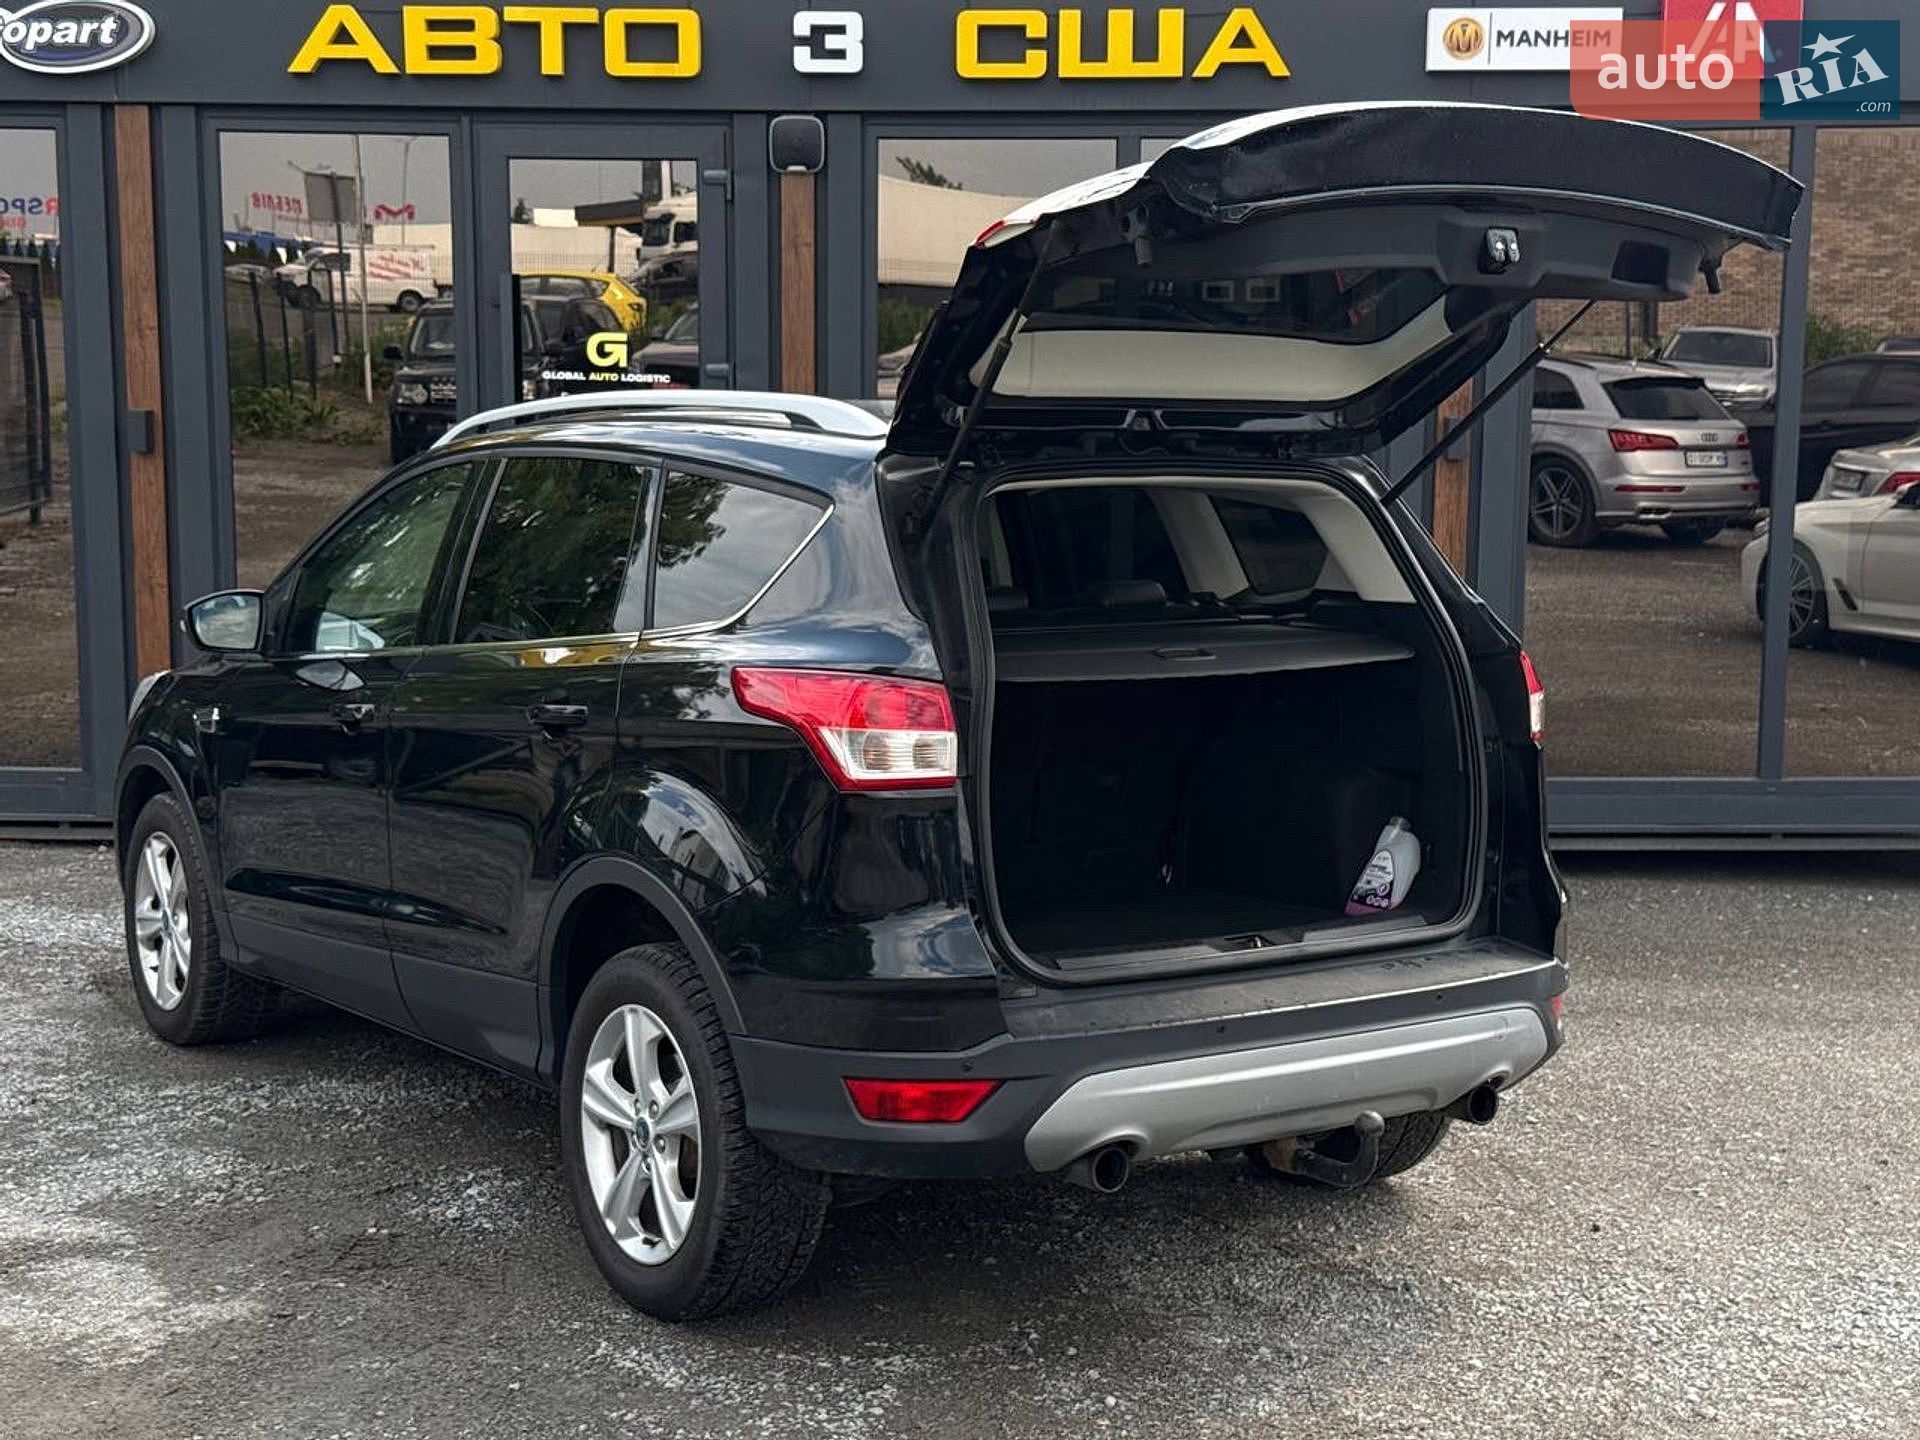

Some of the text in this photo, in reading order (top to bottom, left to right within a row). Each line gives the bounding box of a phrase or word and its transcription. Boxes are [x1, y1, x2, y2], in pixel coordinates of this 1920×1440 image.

[0, 16, 118, 51] opart
[287, 4, 701, 77] АВТО
[956, 7, 1291, 79] США
[1496, 28, 1611, 48] MANHEIM
[542, 371, 671, 383] GLOBAL AUTO LOGISTIC
